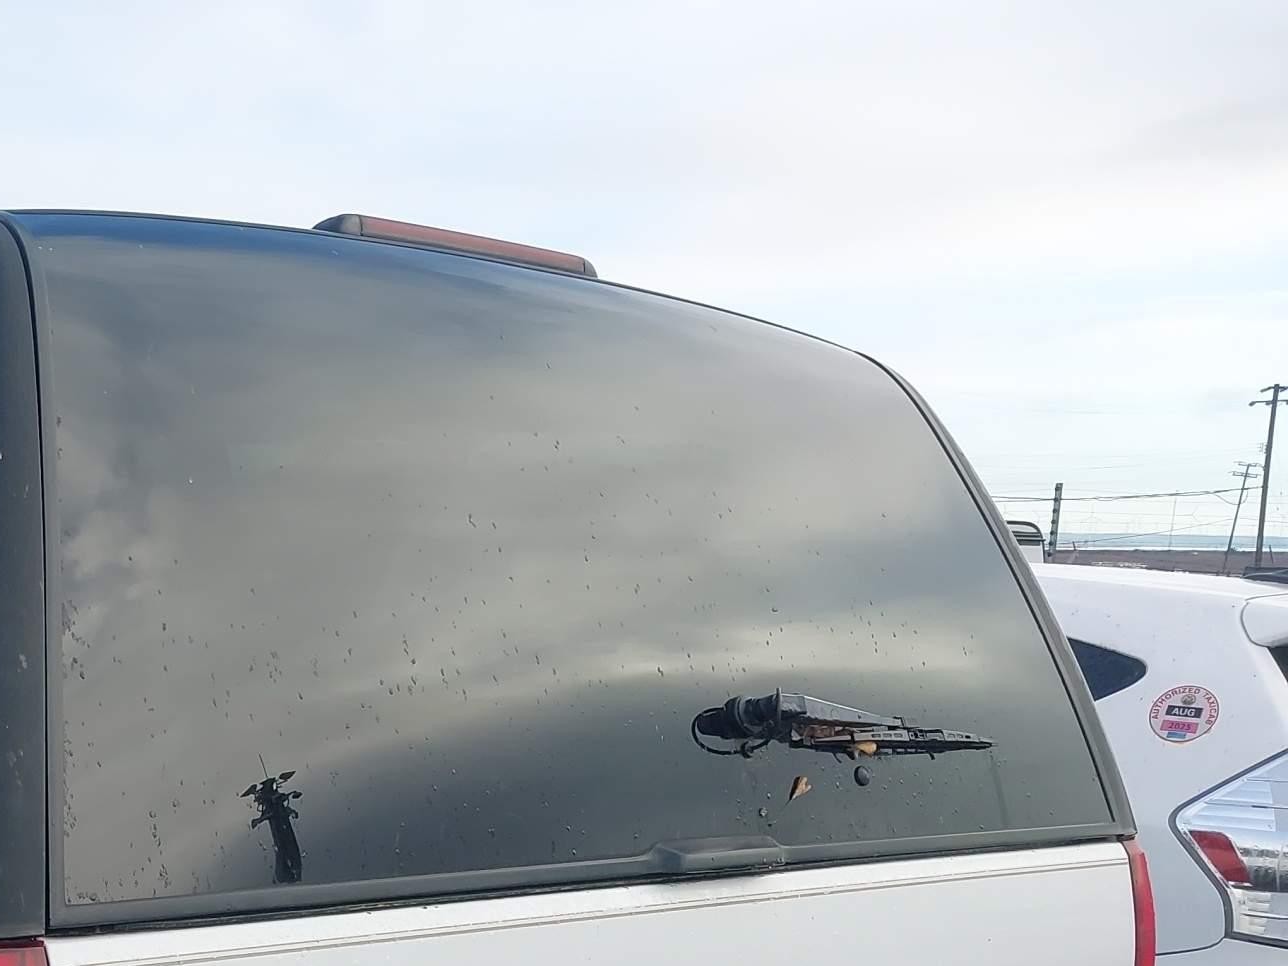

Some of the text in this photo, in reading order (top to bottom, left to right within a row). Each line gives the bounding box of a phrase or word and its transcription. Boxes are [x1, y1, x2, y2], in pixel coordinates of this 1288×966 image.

[1152, 687, 1217, 726] AUTHORIZED TAXICAB
[1171, 707, 1196, 717] AUG
